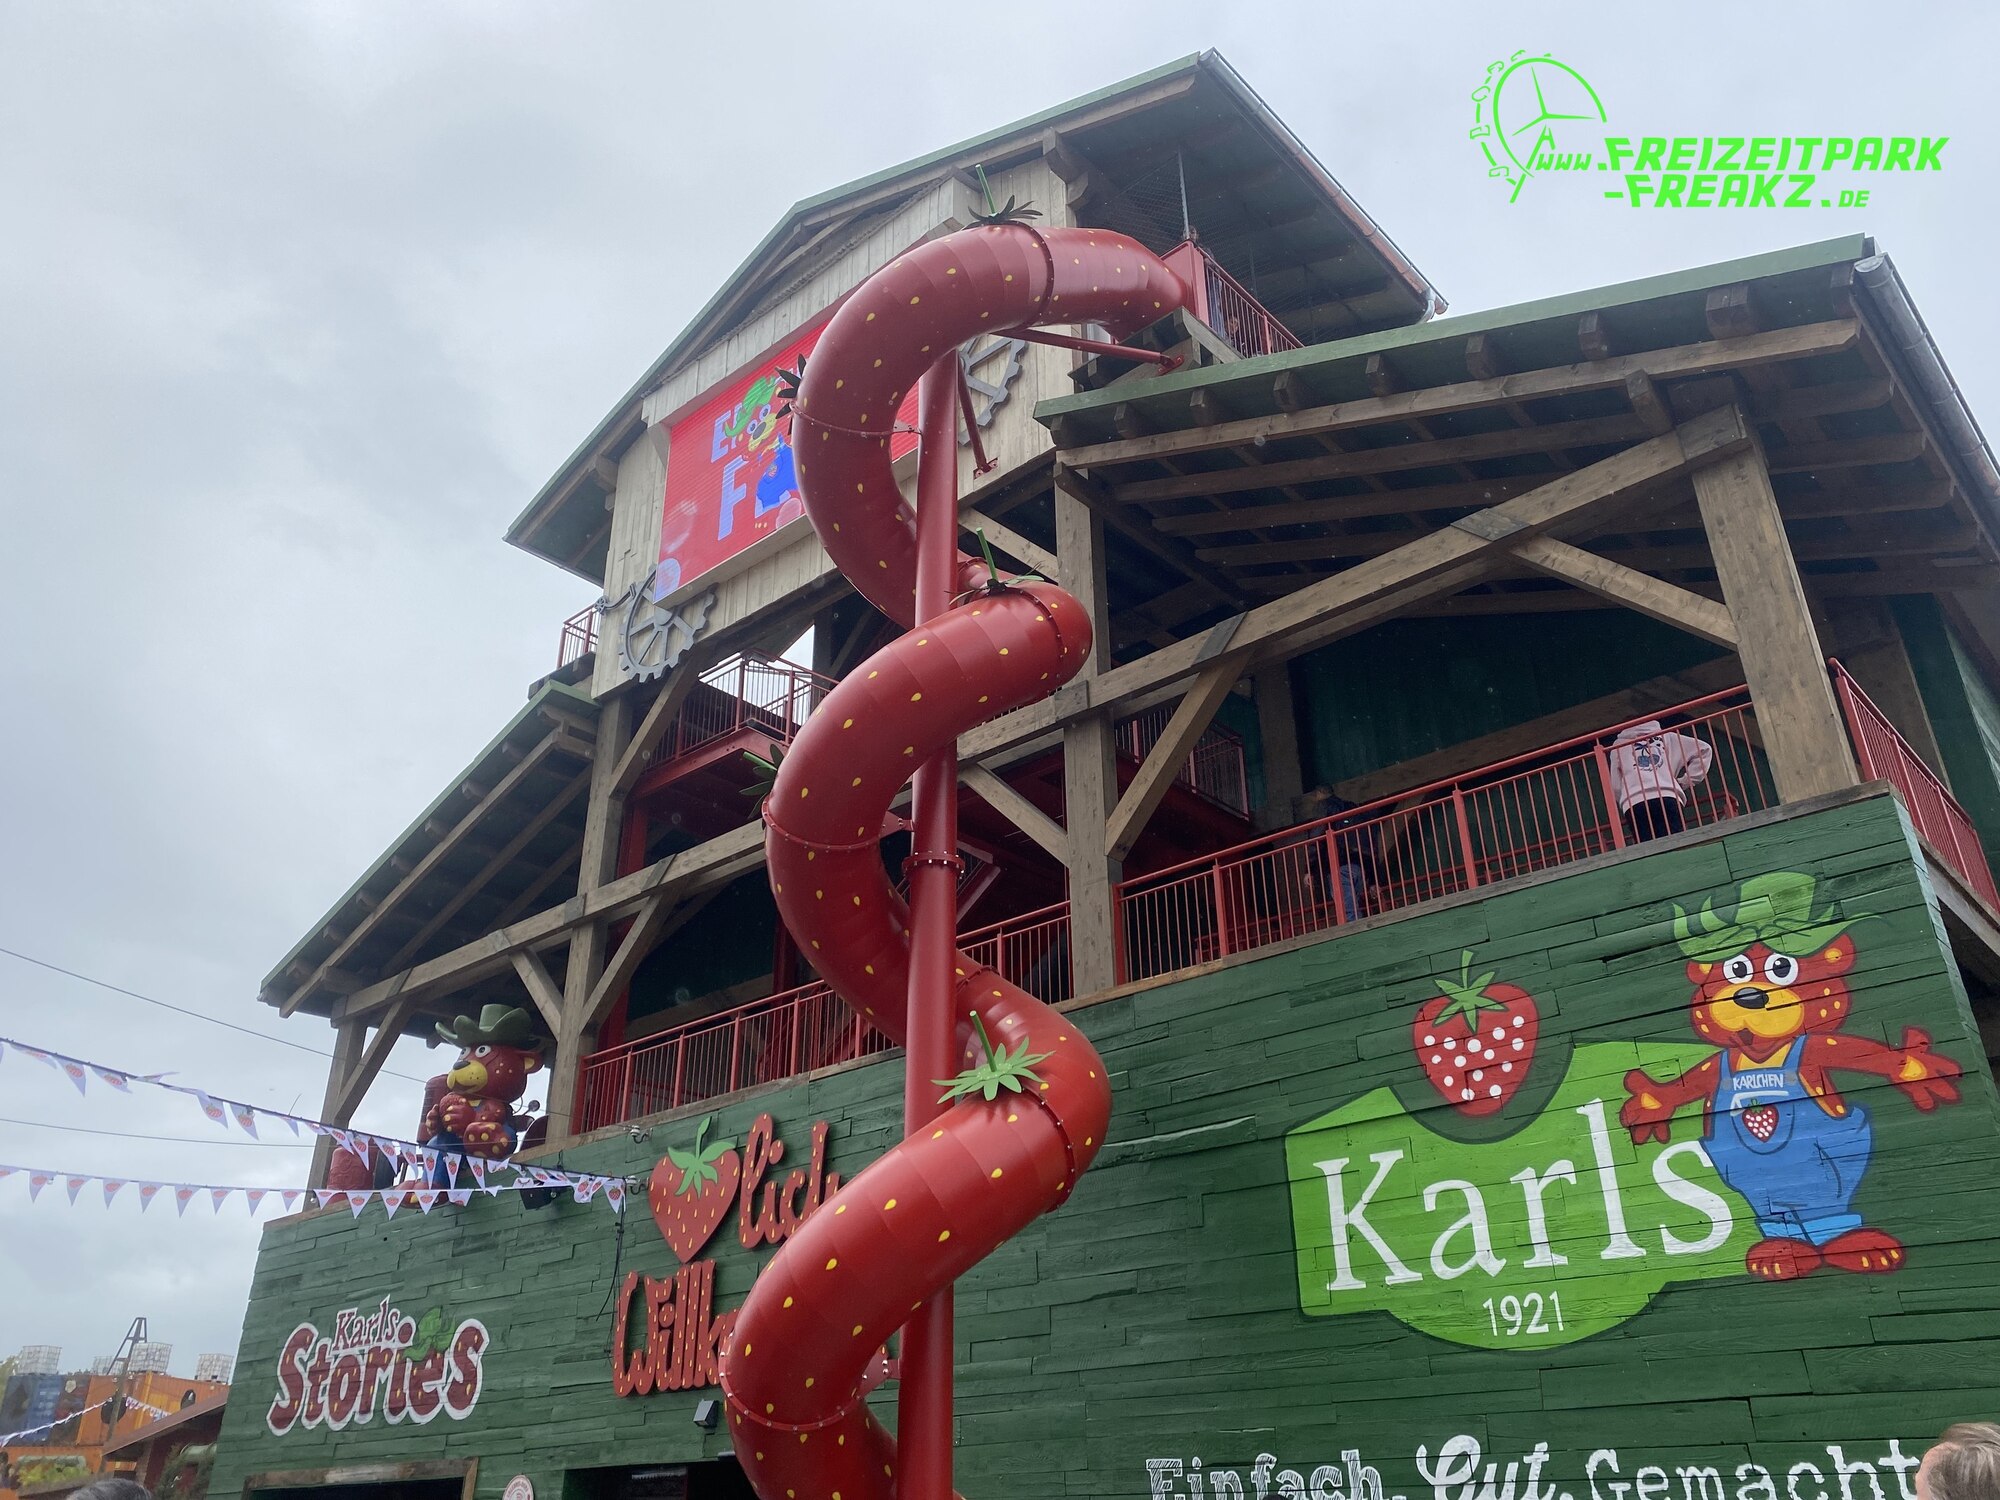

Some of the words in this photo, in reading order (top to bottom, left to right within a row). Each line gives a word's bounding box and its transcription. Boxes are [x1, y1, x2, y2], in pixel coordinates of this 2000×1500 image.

[1733, 1073, 1783, 1091] KARLCHEN
[1313, 1096, 1733, 1291] Karls
[333, 1294, 401, 1350] Karls
[1483, 1290, 1563, 1336] 1921
[266, 1315, 490, 1437] Stories
